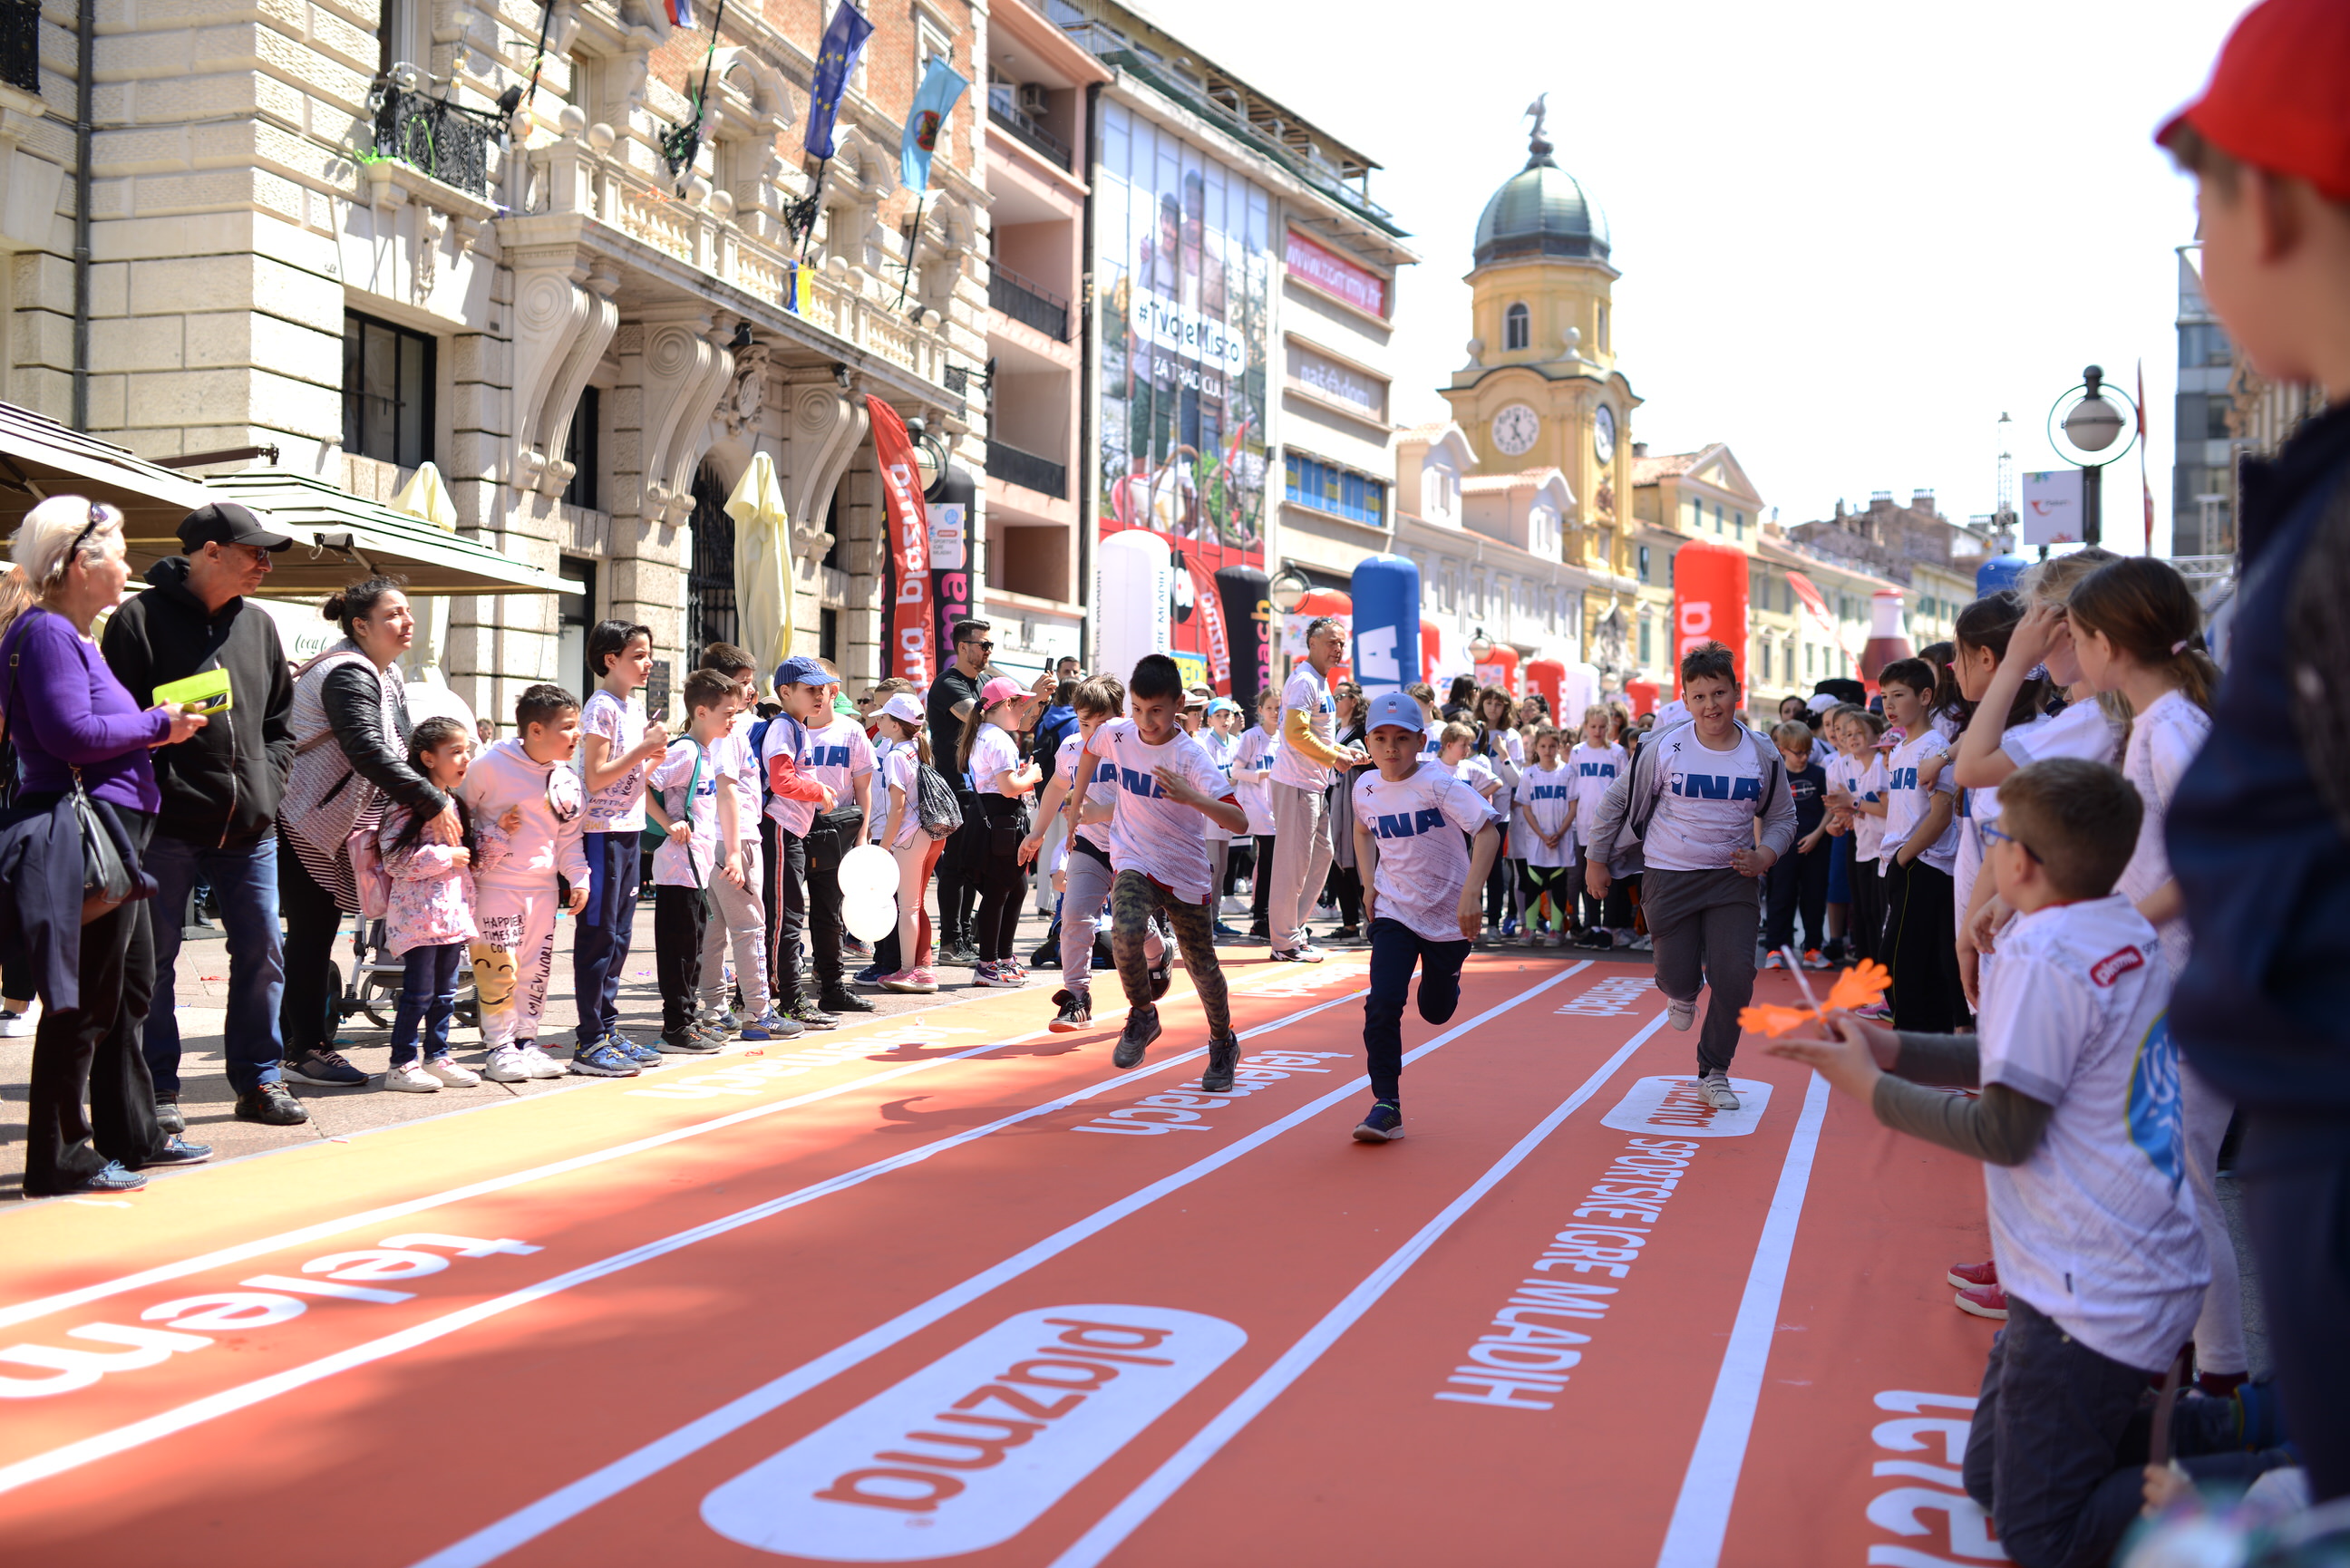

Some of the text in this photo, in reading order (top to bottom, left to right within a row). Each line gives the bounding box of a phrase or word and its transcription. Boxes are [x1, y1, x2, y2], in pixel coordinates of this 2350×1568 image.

[1671, 772, 1762, 802] INA
[1368, 807, 1446, 840] INA
[481, 925, 525, 942] TIMES ARE
[482, 914, 524, 929] HAPPIER
[490, 940, 523, 953] COMING
[1070, 1050, 1355, 1136] telemach
[1433, 1137, 1701, 1410] SPORTSKE IGRE MLADIH
[811, 1317, 1175, 1514] plazma
